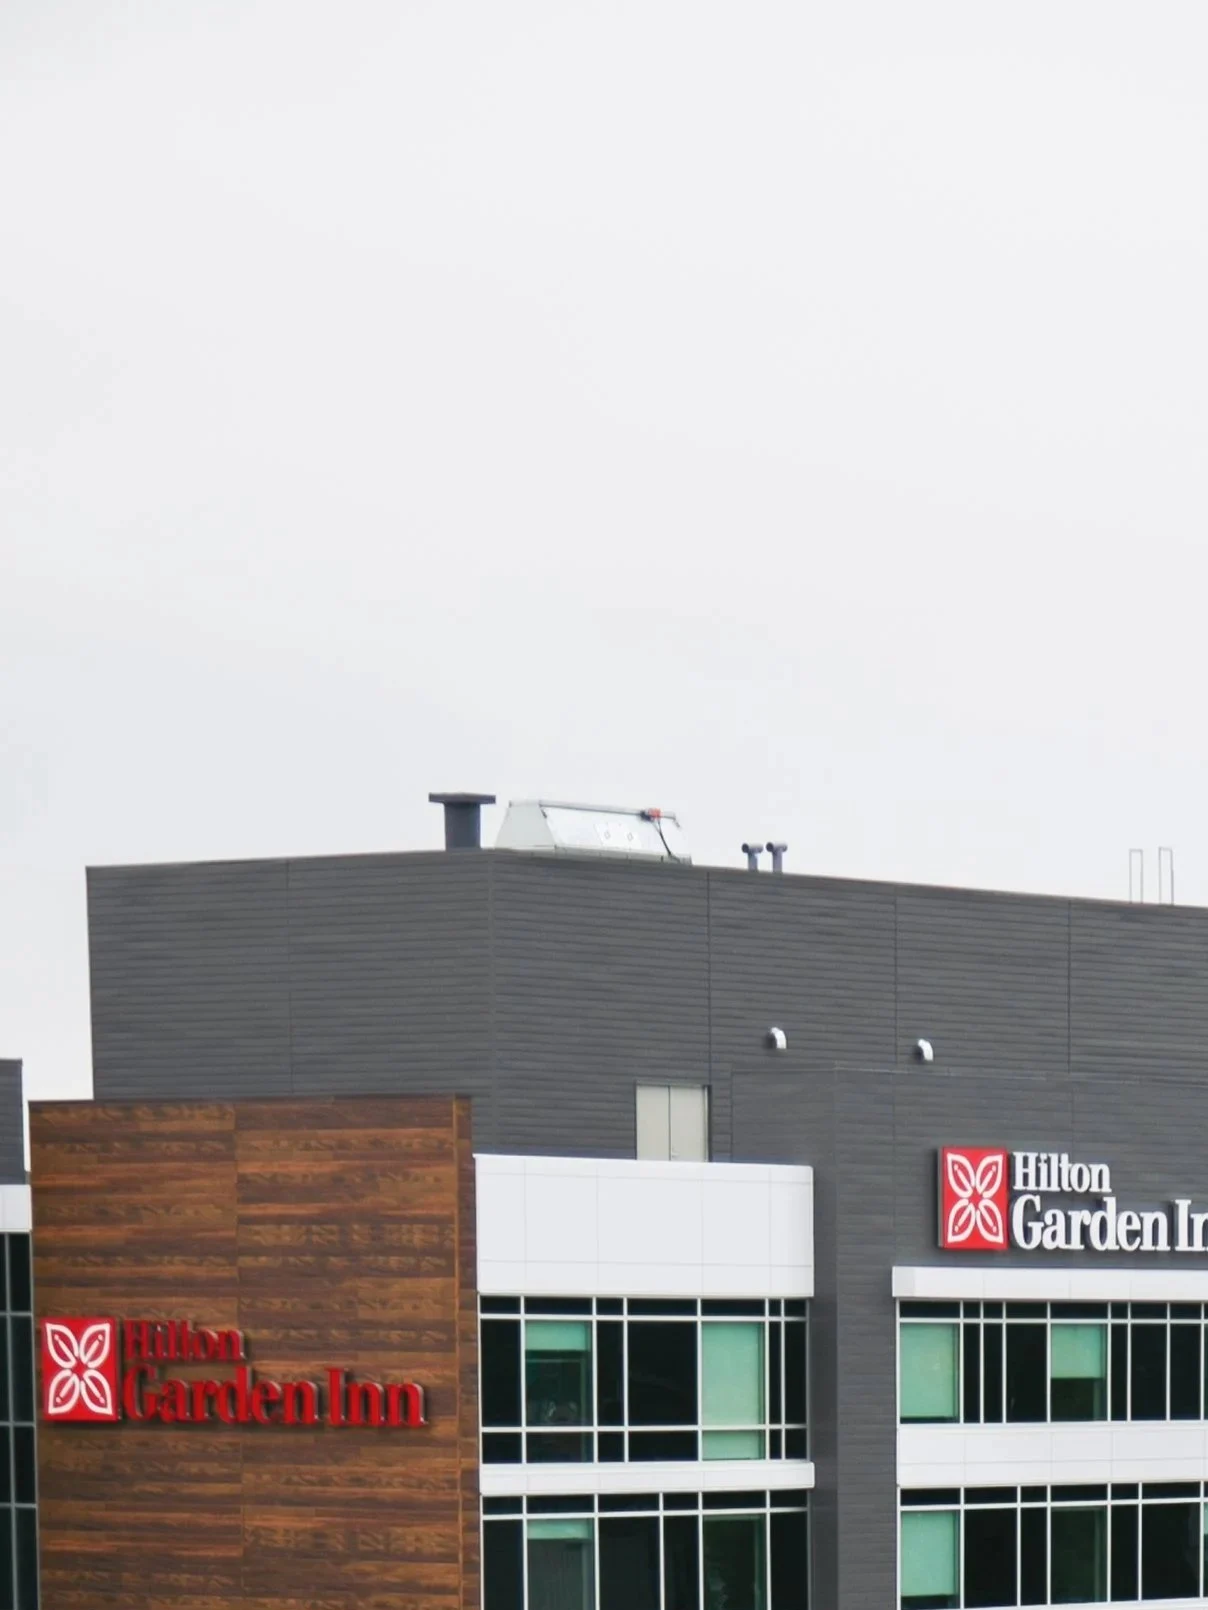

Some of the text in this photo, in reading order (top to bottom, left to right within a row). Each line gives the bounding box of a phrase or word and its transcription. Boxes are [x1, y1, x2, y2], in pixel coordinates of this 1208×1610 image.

[1012, 1151, 1112, 1193] Hilton
[1012, 1194, 1171, 1251] Garden
[123, 1319, 246, 1361] Hilton
[123, 1363, 427, 1427] Garden Inn
